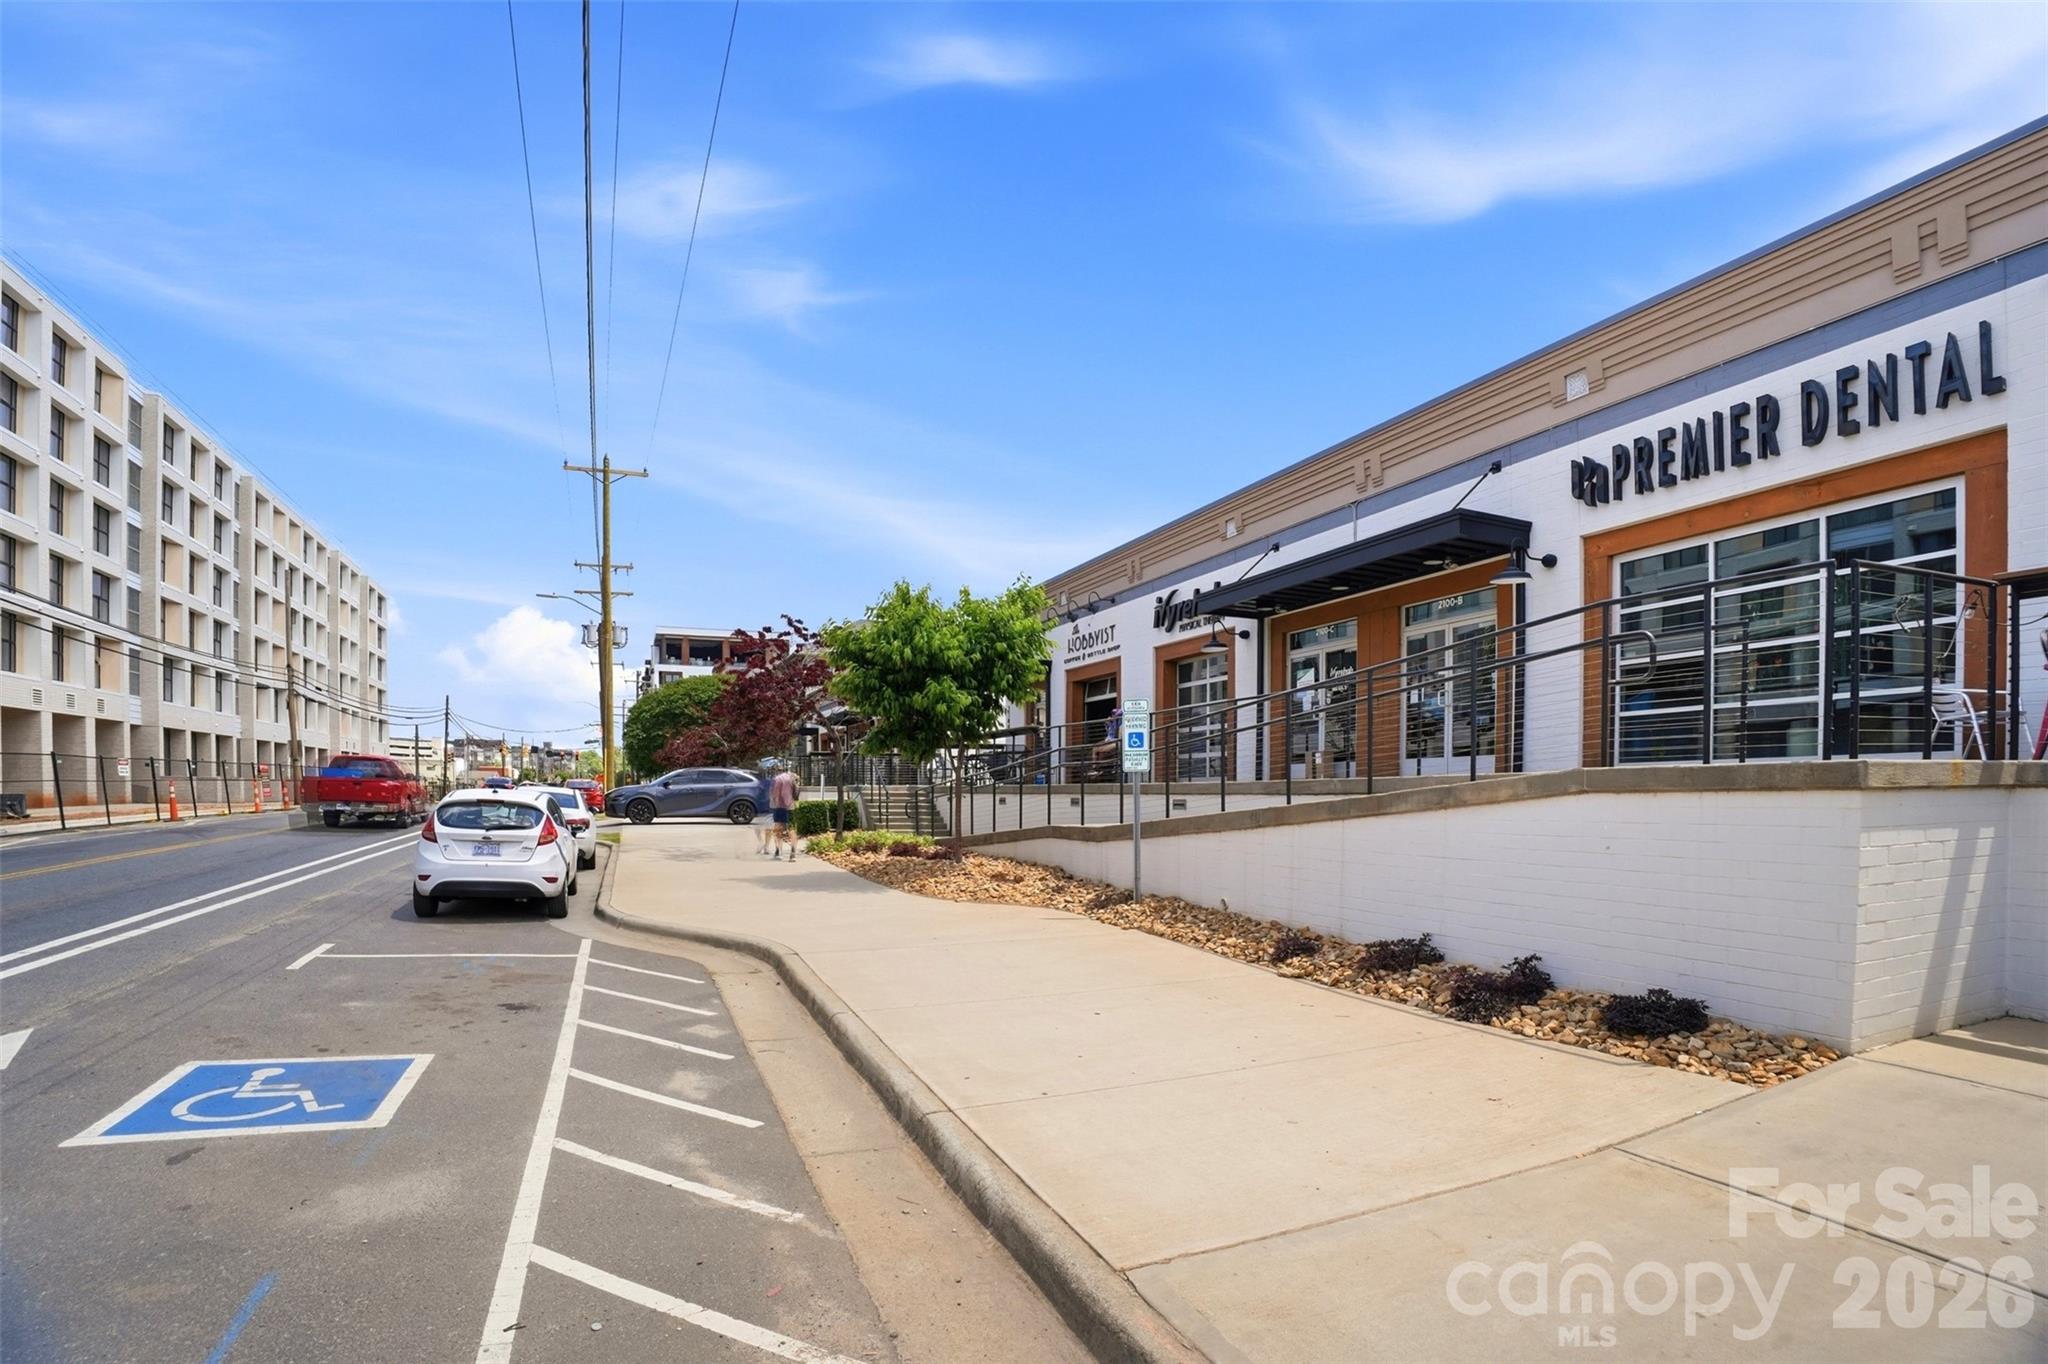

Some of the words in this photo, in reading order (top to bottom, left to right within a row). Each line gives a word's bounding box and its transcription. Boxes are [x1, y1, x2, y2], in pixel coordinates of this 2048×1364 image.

[1612, 393, 1781, 501] PREMIER
[1800, 320, 2007, 447] DENTAL
[1438, 596, 1464, 609] 2100-B
[1067, 624, 1116, 654] HOBBYIST
